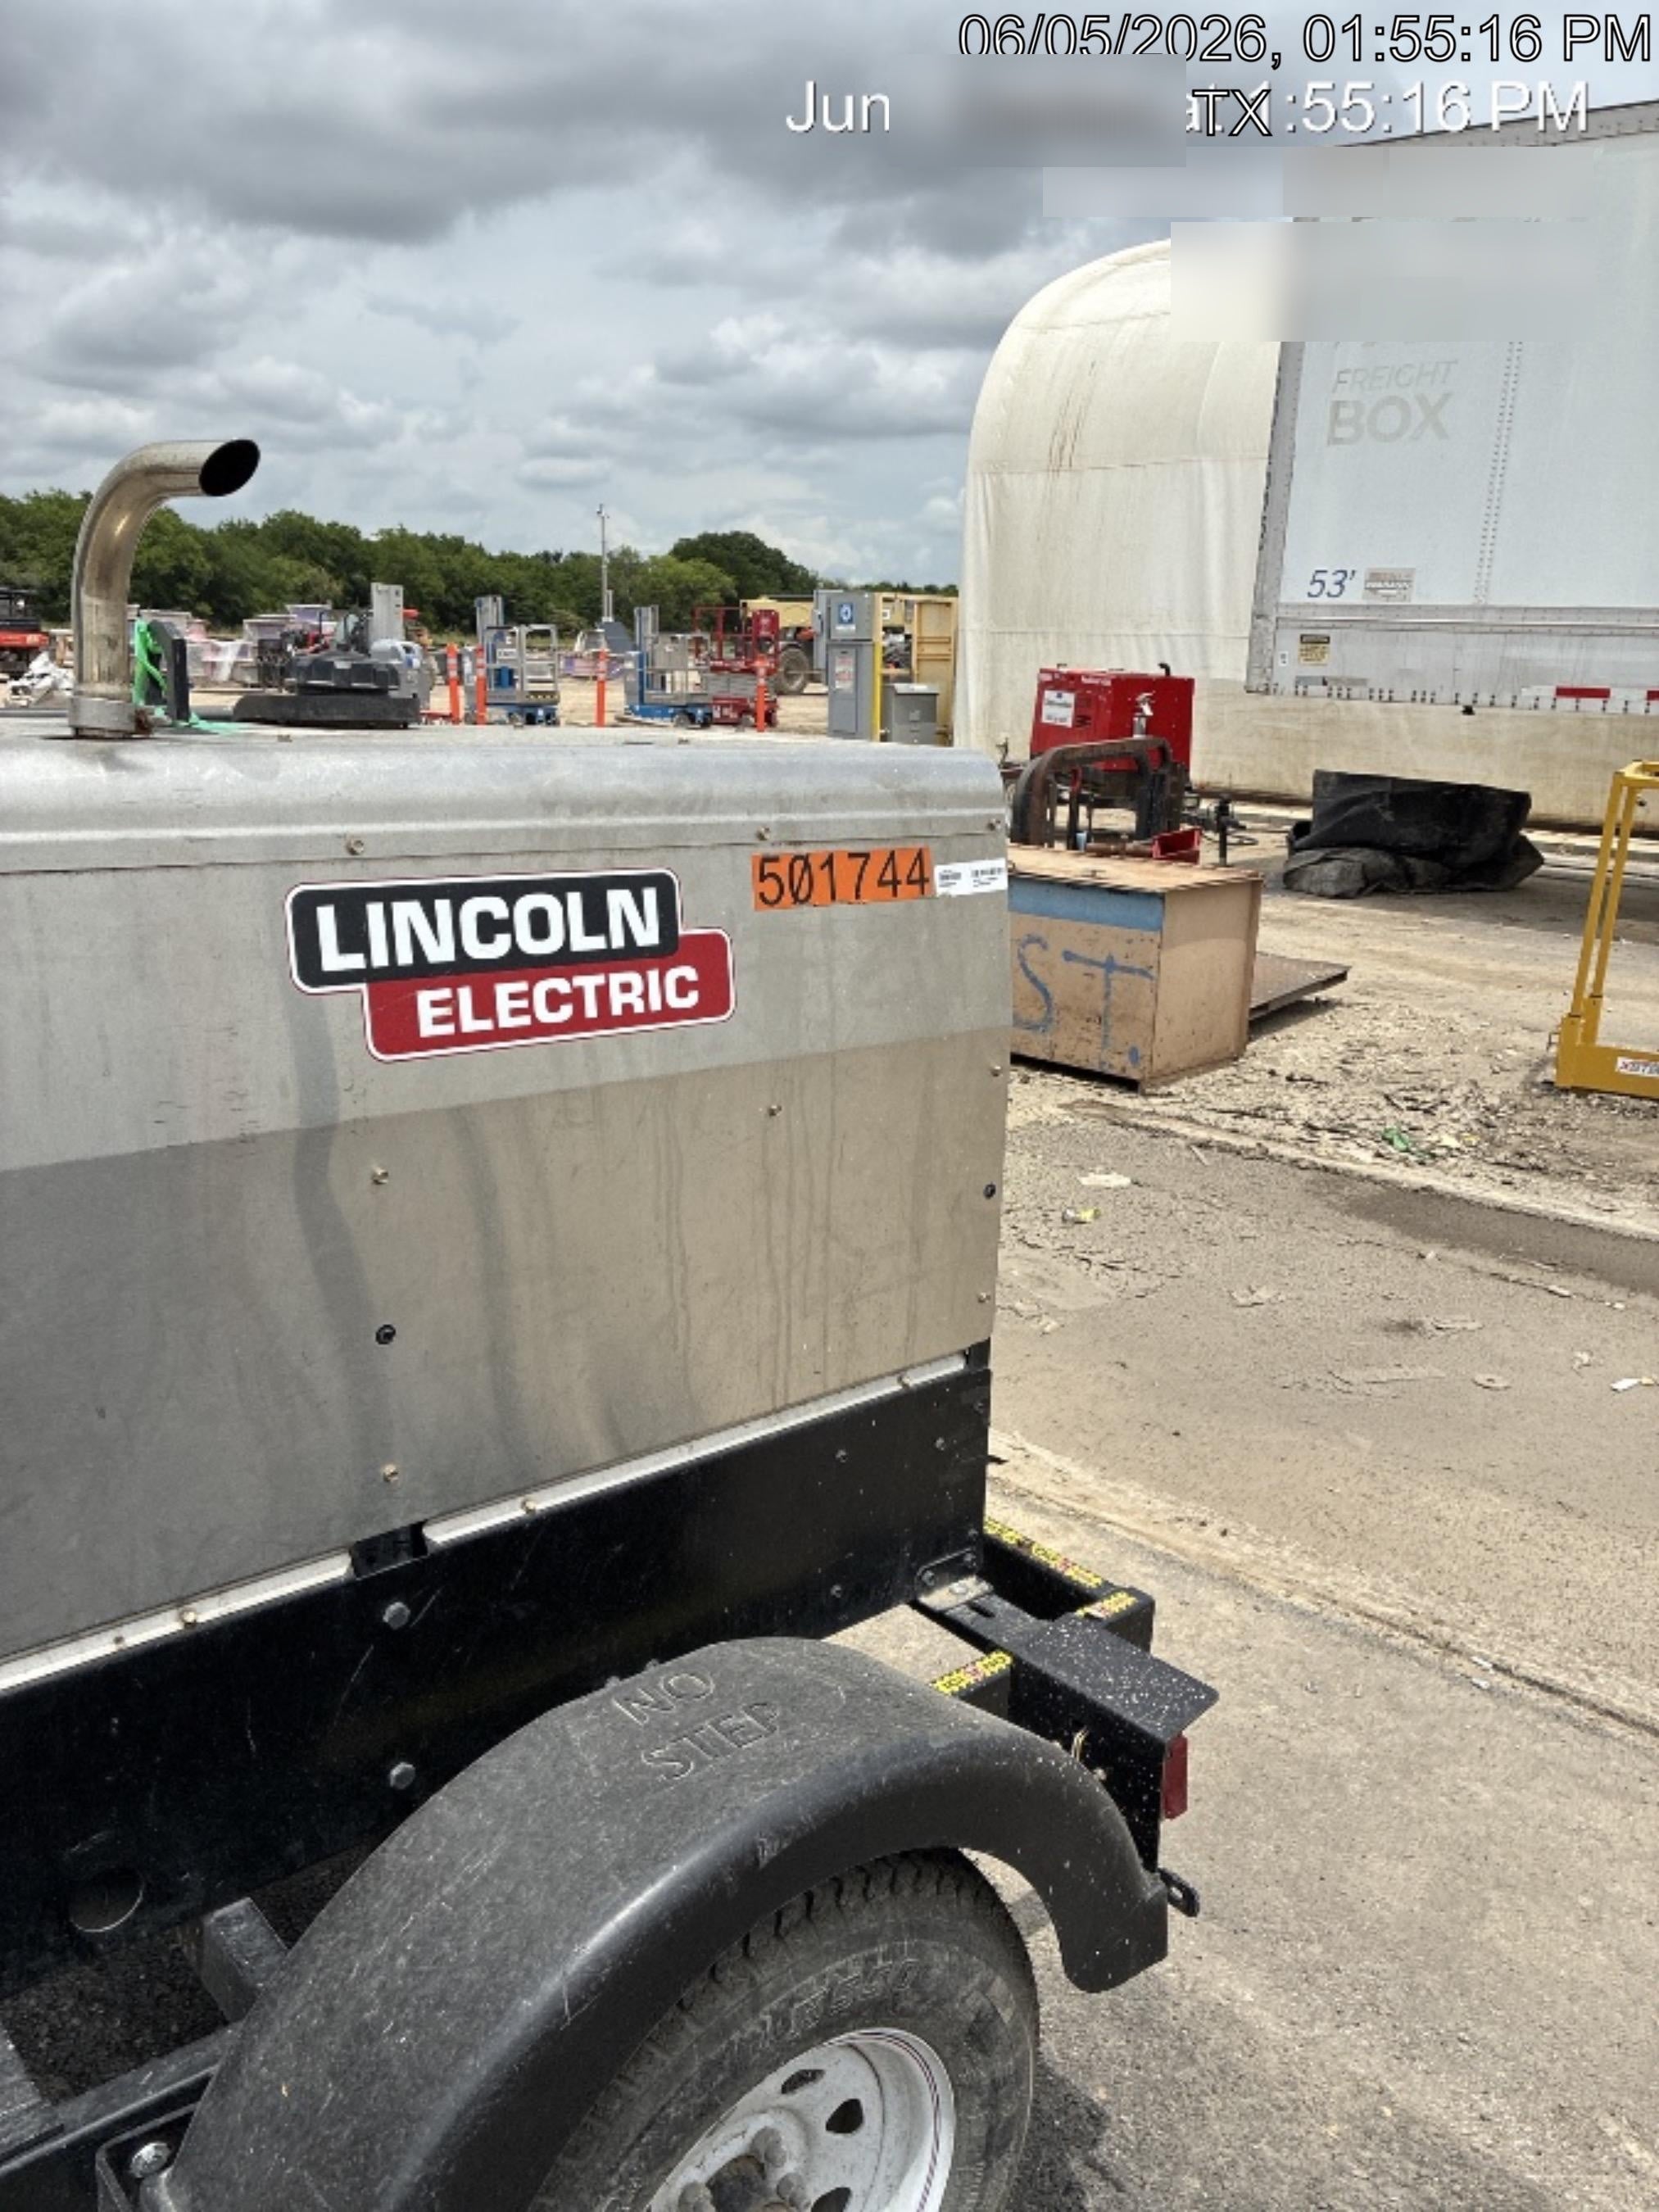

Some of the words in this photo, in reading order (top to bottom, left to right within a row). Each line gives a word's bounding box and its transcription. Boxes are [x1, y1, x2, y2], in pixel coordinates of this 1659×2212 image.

[1331, 360, 1459, 393] FREIGHT
[1326, 392, 1453, 447] BOX
[759, 848, 930, 906] 501744
[315, 886, 660, 972] LINCOLN
[416, 965, 700, 1039] ELECTRIC
[611, 1672, 715, 1726] NO
[641, 1701, 781, 1782] STEP
